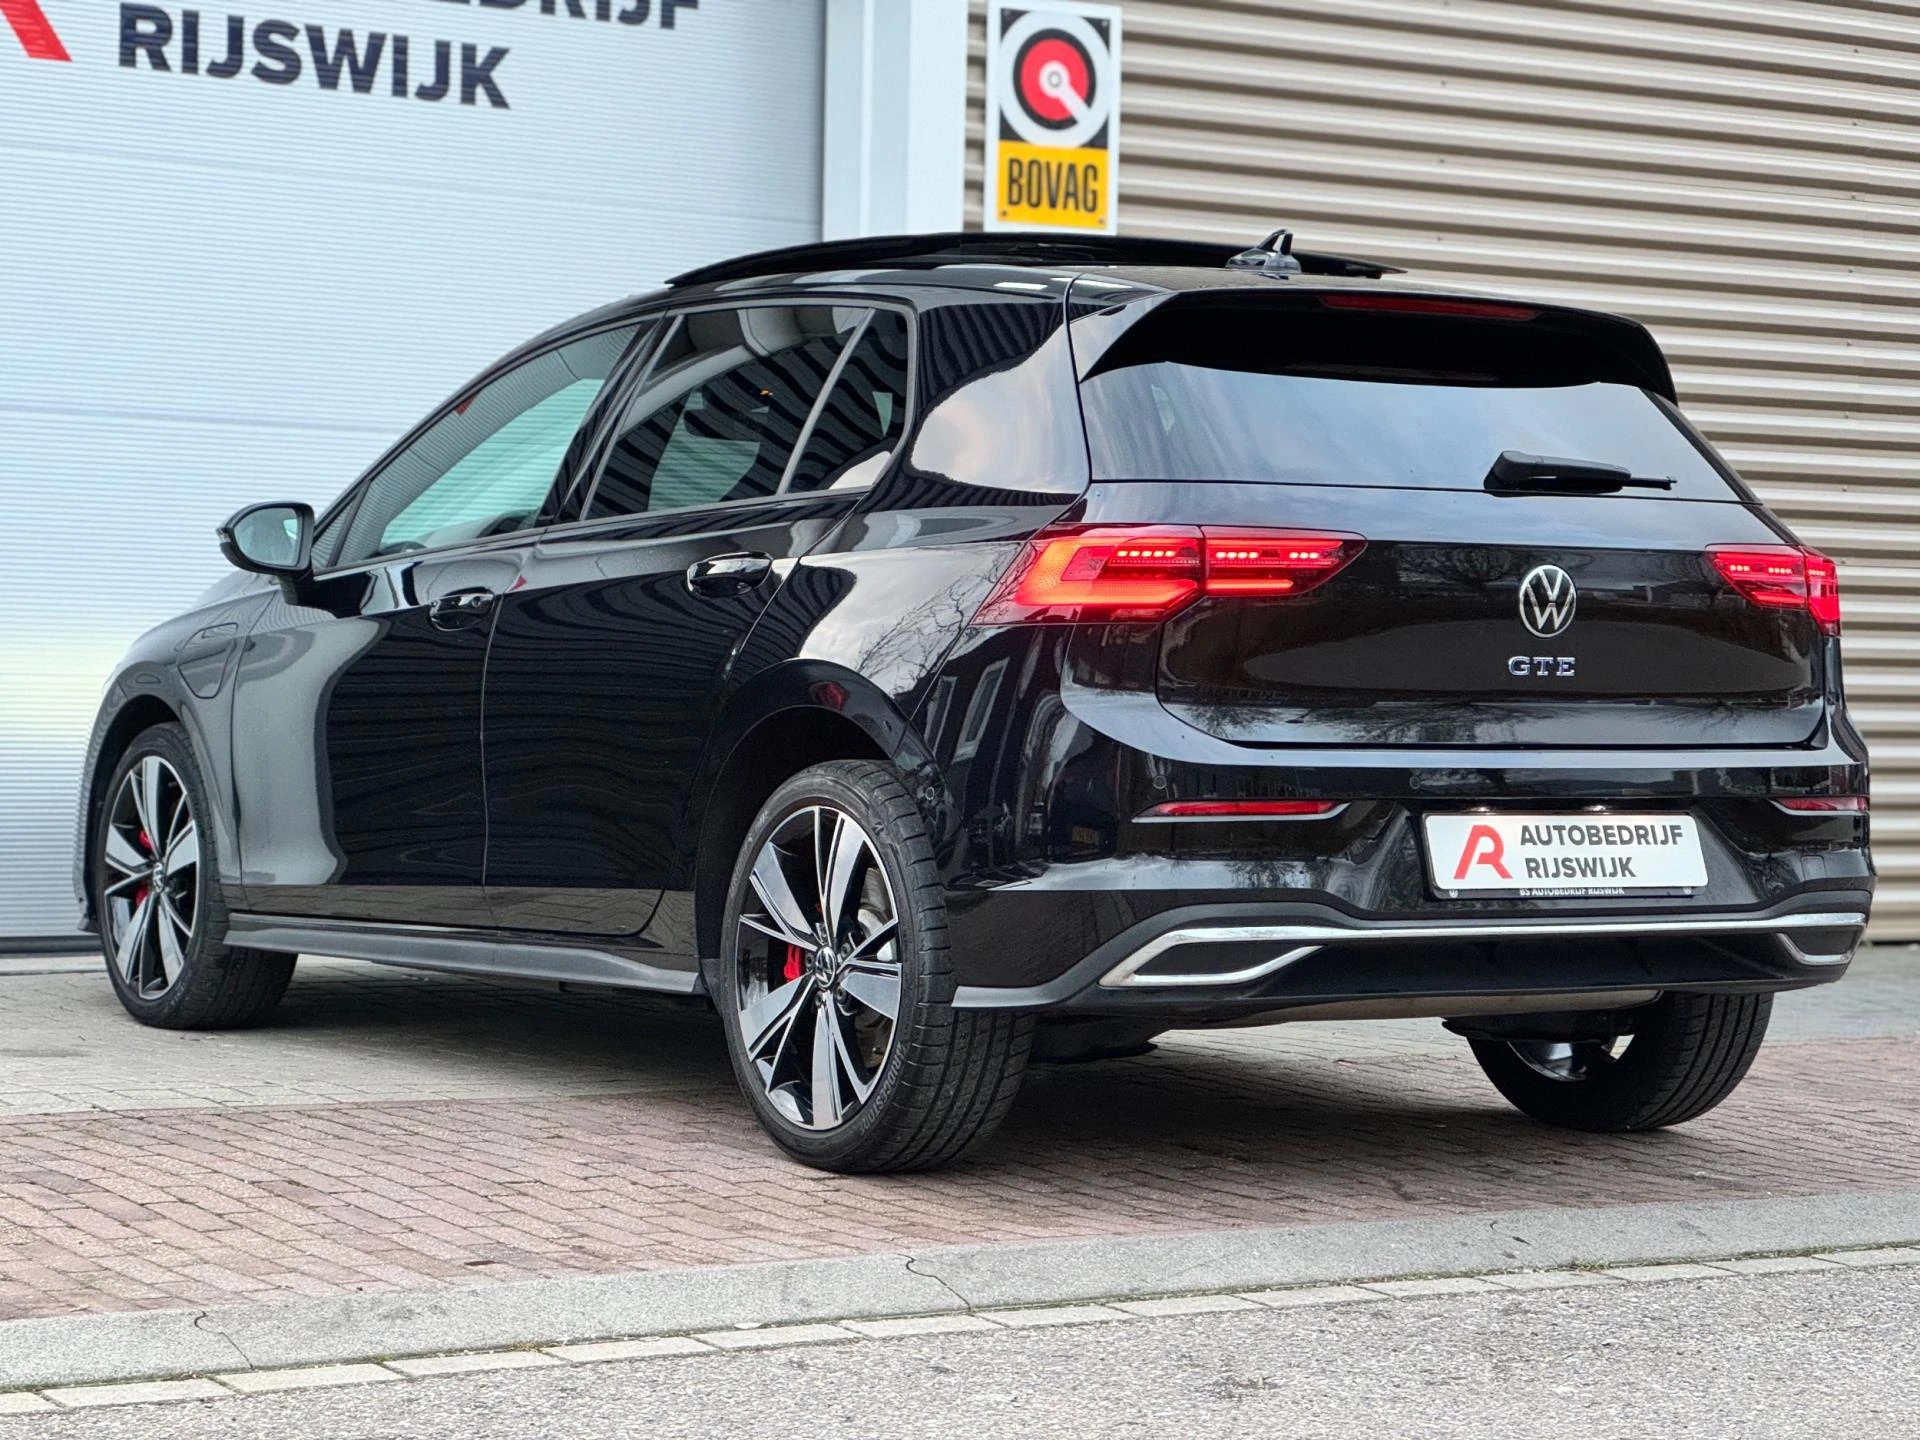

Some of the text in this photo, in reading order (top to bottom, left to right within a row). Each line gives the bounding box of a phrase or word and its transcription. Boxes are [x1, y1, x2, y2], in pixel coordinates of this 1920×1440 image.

[119, 2, 511, 110] RIJSWIJK
[1008, 158, 1098, 213] BOVAG
[1507, 655, 1576, 676] GTE
[1520, 824, 1684, 846] AUTOBEDRIJF
[1524, 856, 1637, 879] RIJSWIJK
